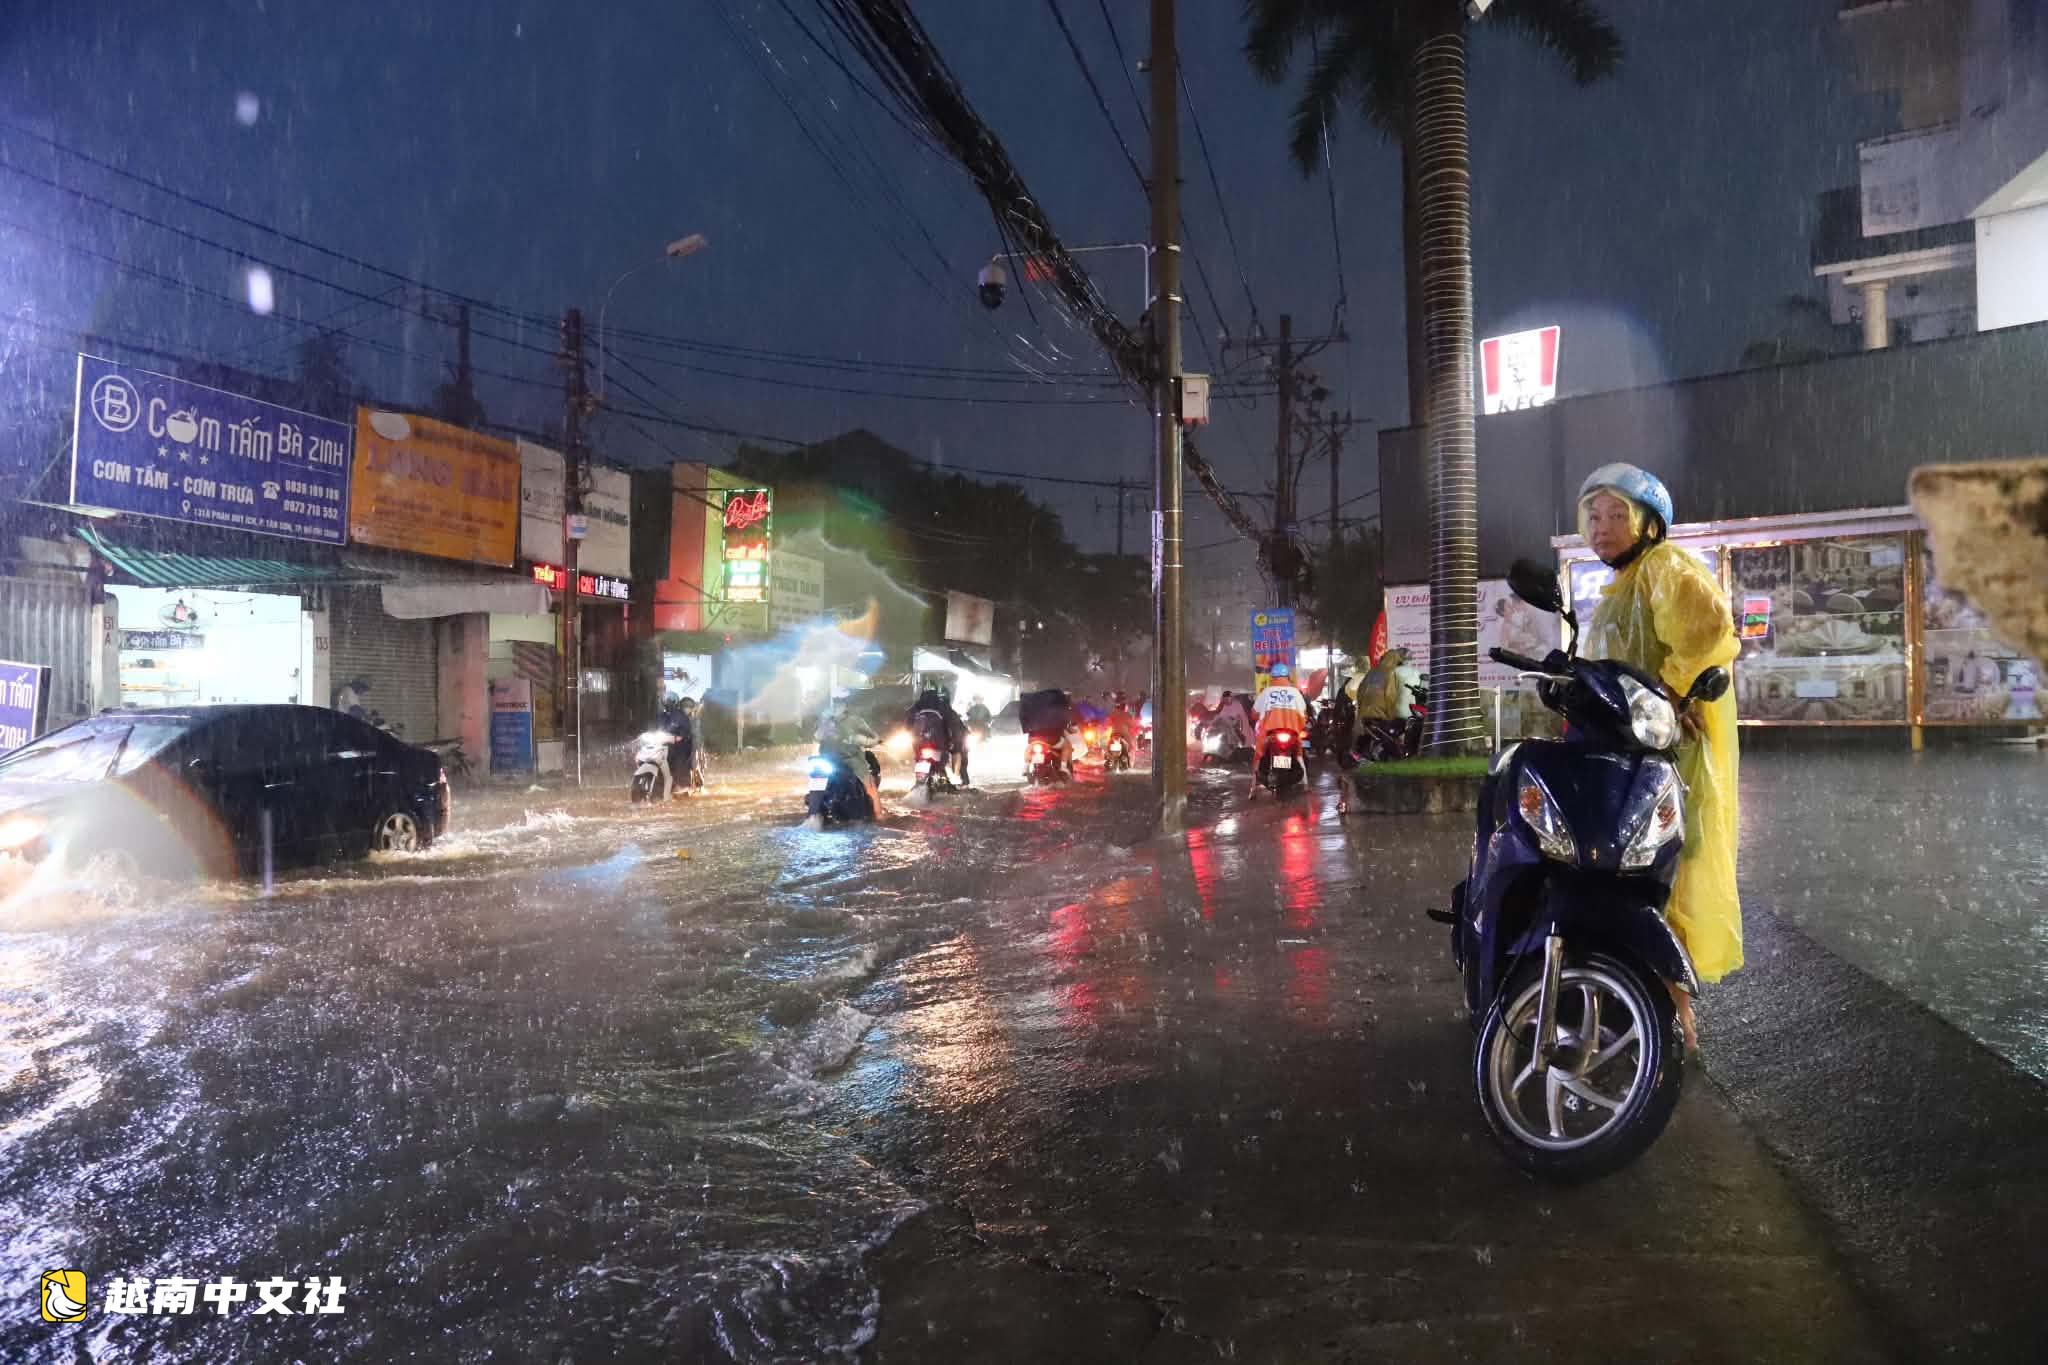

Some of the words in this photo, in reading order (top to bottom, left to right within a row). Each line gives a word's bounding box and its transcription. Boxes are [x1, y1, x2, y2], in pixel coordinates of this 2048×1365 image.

[278, 422, 303, 459] BÀ
[308, 436, 344, 467] ZINH
[93, 459, 131, 484] CƠM
[135, 463, 169, 490] TẤM
[183, 475, 216, 499] CƠM
[220, 483, 255, 505] TRƯA
[9, 671, 33, 710] TẤM
